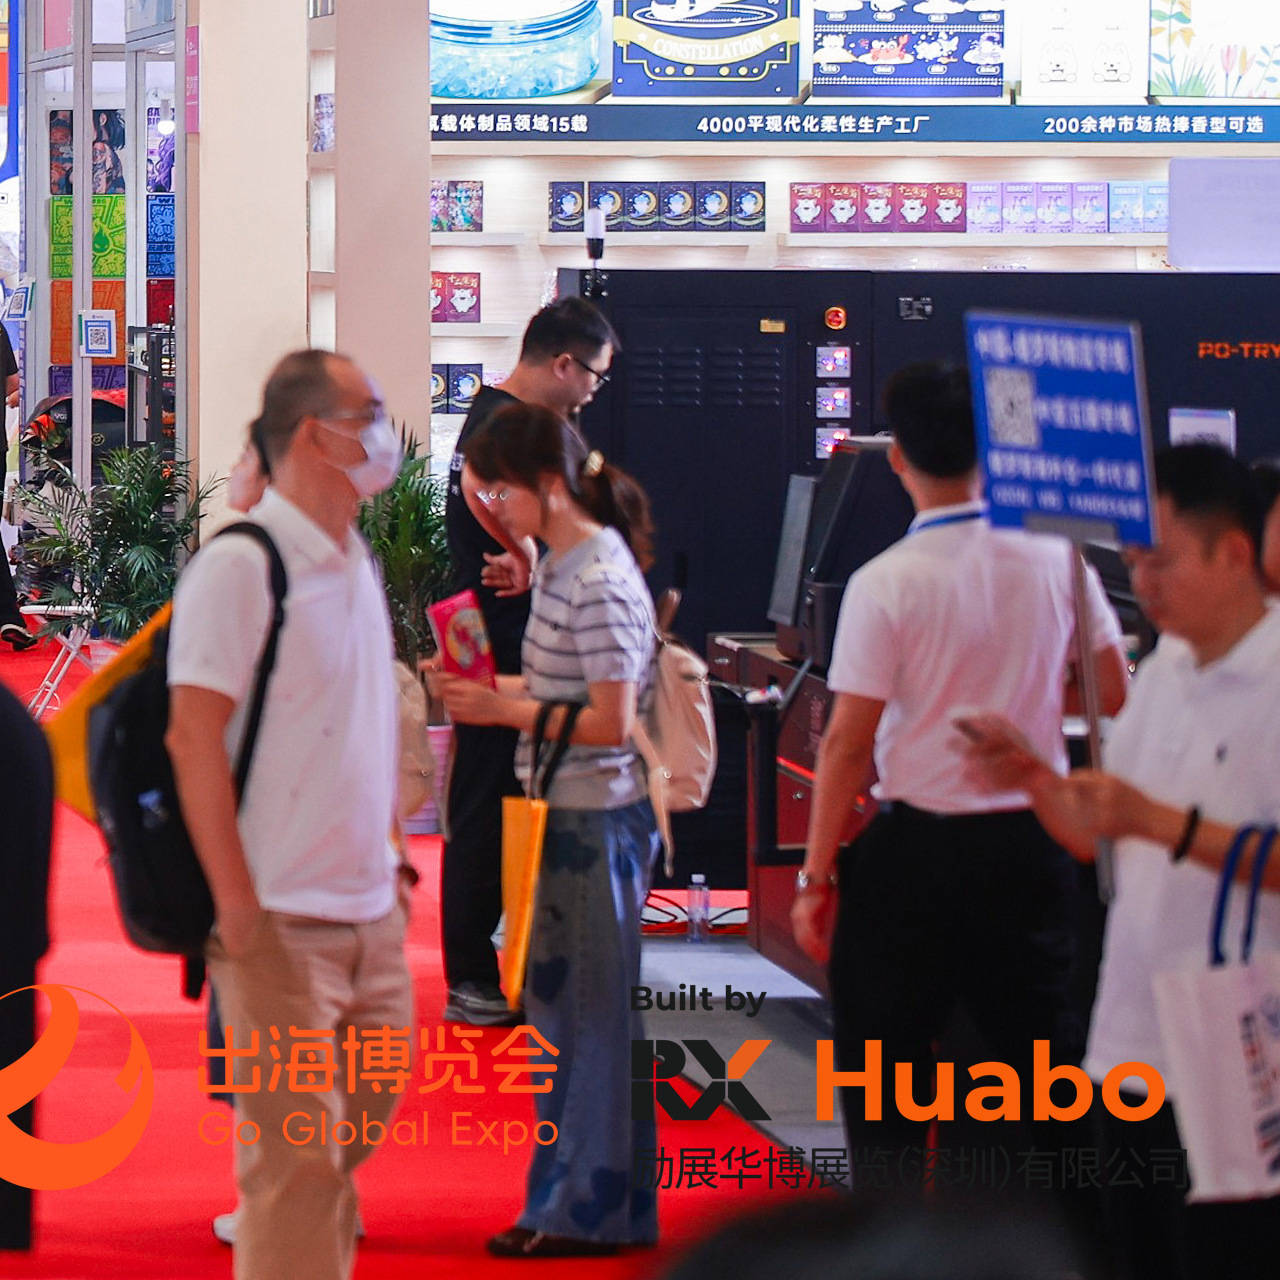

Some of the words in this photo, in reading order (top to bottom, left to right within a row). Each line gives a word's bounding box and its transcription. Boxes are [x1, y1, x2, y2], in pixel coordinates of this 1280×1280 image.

[653, 35, 765, 60] CONSTELLATION
[697, 114, 931, 134] 4000平现代化柔性生产工厂
[1044, 115, 1264, 134] 200余种市场热捧香型可选
